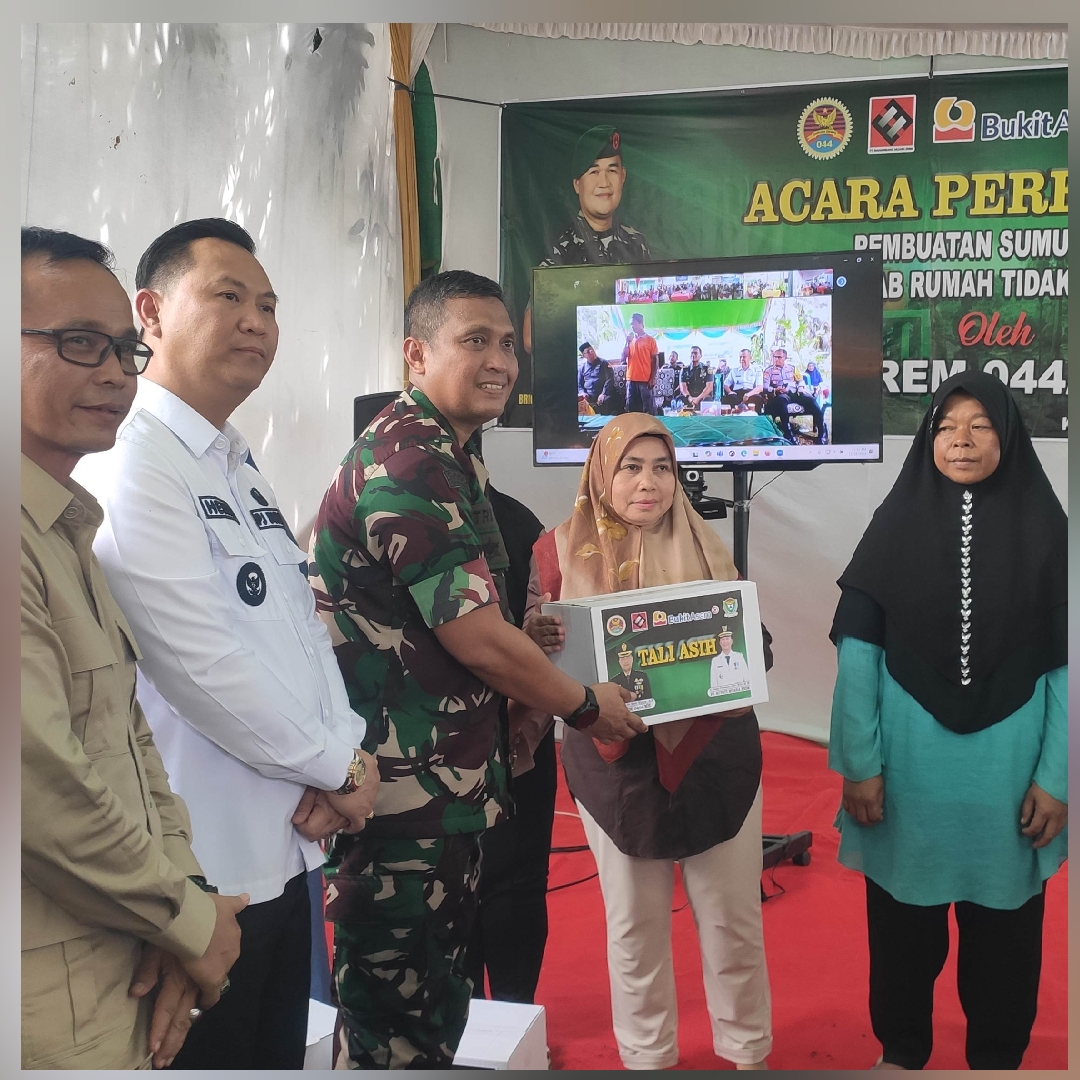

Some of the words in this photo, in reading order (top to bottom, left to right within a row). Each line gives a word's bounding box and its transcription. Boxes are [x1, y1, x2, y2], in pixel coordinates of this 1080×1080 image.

[743, 176, 919, 224] ACARA
[854, 231, 992, 259] PEMBUATAN
[1000, 229, 1068, 258] SUMU
[911, 270, 992, 298] RUMAH
[1001, 268, 1068, 297] TIDAK
[958, 311, 1035, 346] Oleh
[637, 644, 675, 667] TALI
[679, 638, 717, 660] ASIH
